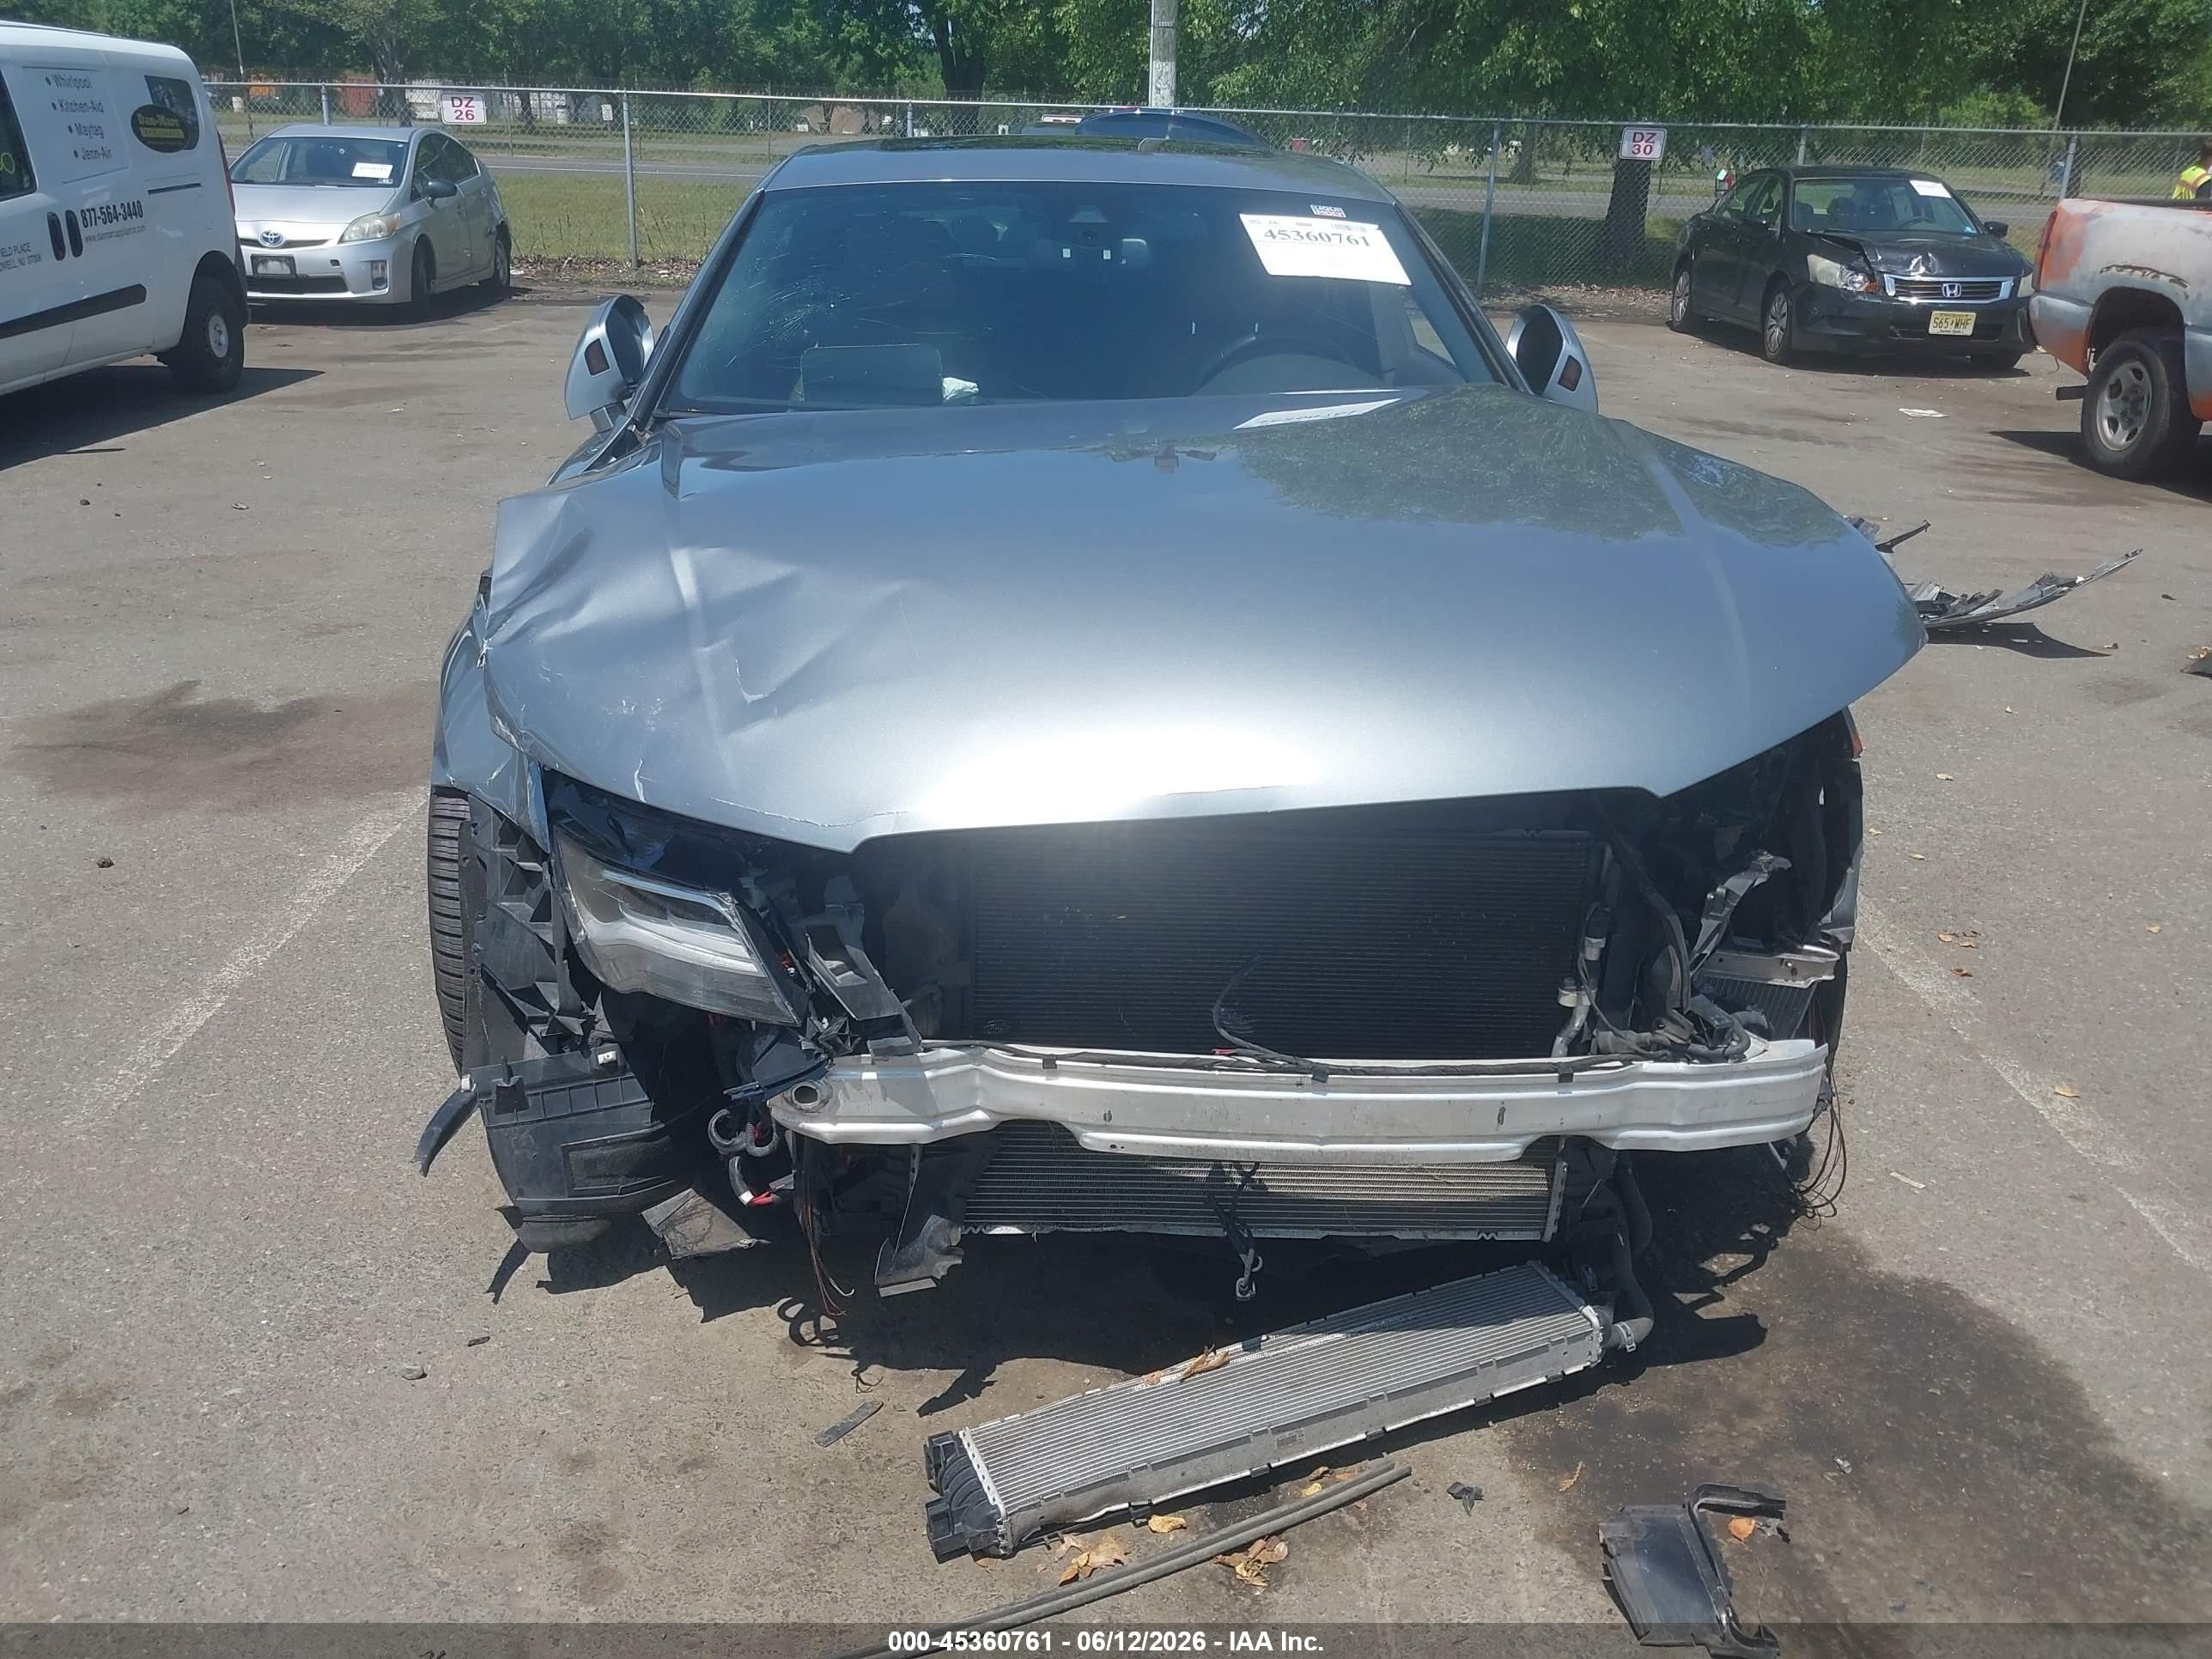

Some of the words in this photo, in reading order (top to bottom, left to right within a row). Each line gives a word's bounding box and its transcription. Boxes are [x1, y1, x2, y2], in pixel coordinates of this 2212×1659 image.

[52, 75, 92, 90] Whirlpool
[58, 99, 104, 113] Kitchen-Aid
[451, 96, 475, 108] DZ
[453, 109, 475, 121] 26
[75, 123, 105, 139] Maytag
[1632, 131, 1657, 144] DZ
[82, 147, 112, 161] Jenn-Air
[1632, 143, 1654, 155] 30
[80, 200, 144, 228] 877-564-3440
[1264, 228, 1371, 246] 45360761
